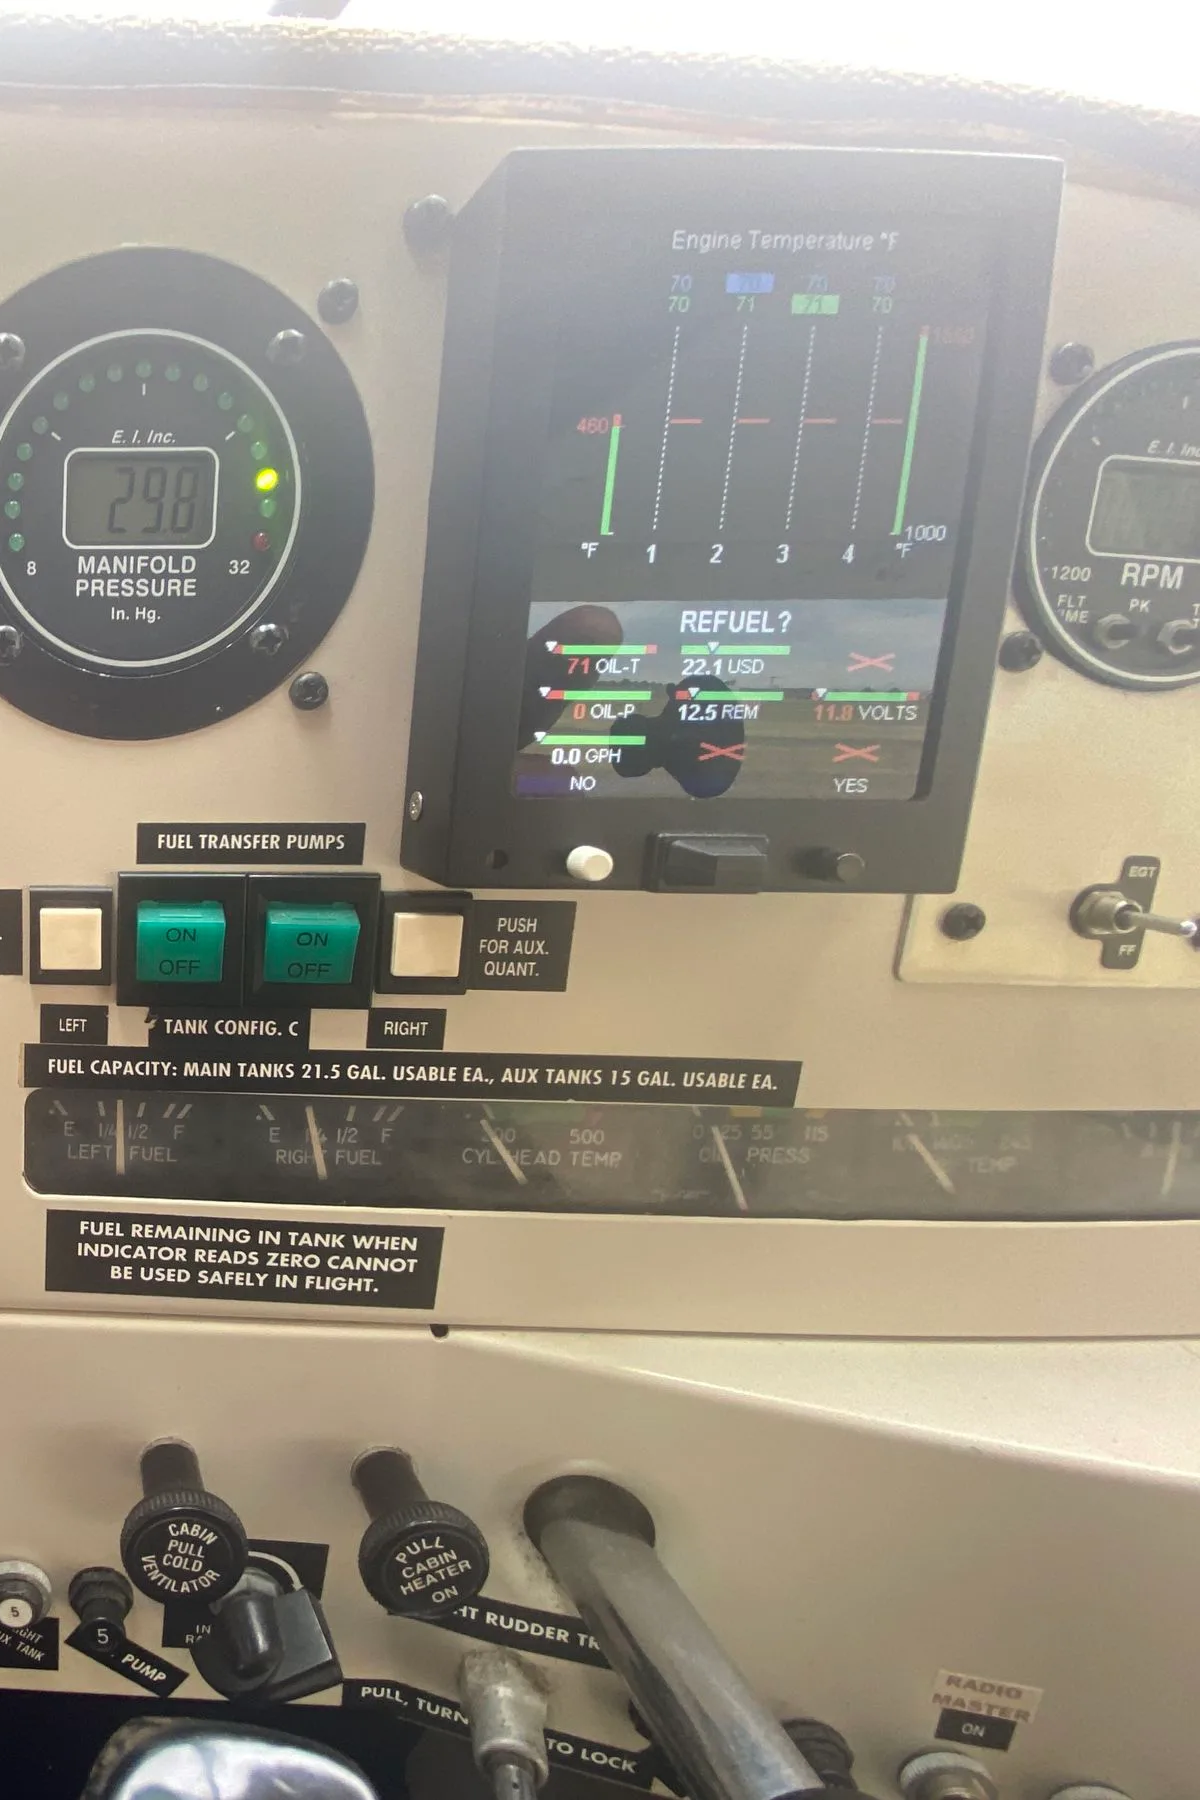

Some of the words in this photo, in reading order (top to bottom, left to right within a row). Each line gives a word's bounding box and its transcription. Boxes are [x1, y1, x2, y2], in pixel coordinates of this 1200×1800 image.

[672, 229, 742, 254] Engine
[748, 229, 874, 252] Temperature
[905, 525, 947, 541] 1000
[78, 556, 196, 574] MANIFOLD
[229, 561, 250, 575] 32
[1051, 566, 1091, 582] 1200
[1121, 564, 1184, 589] RPM
[76, 579, 197, 597] PRESSURE
[111, 607, 129, 620] In.
[136, 607, 161, 622] Hg.
[680, 610, 792, 633] REFUEL?
[682, 659, 721, 675] 22.1
[729, 659, 764, 674] USD
[678, 705, 717, 720] 12.5
[721, 705, 759, 720] REM
[859, 705, 917, 720] VOLTS
[570, 776, 596, 791] NO
[833, 778, 869, 793] YES
[157, 835, 193, 849] FUEL
[199, 835, 281, 850] TRANSFER
[286, 835, 345, 850] PUMPS
[1128, 866, 1156, 878] EGT
[166, 928, 197, 942] ON
[1118, 944, 1137, 956] FF
[159, 960, 200, 975] OFF
[59, 1018, 87, 1032] LEFT
[384, 1022, 428, 1036] RIGHT
[48, 1059, 84, 1074] FUEL
[90, 1060, 177, 1076] CAPACITY:
[183, 1062, 230, 1077] MAIN
[238, 1063, 293, 1078] TANKS
[301, 1064, 341, 1079] 21.5
[347, 1065, 386, 1081] GAL.
[393, 1066, 457, 1082] USABLE
[463, 1067, 494, 1085] EA.,
[502, 1068, 539, 1084] AUX
[546, 1069, 602, 1085] TANKS
[610, 1070, 630, 1085] 15
[637, 1070, 676, 1087] GAL.
[683, 1072, 747, 1089] USABLE
[751, 1073, 777, 1090] EA.
[68, 1145, 111, 1160] LEFT
[130, 1147, 177, 1162] FUEL
[80, 1221, 124, 1237] FUEL
[131, 1224, 250, 1243] REMAINING
[259, 1231, 281, 1244] IN
[289, 1232, 344, 1248] TANK
[353, 1235, 418, 1251] WHEN
[77, 1242, 187, 1262] INDICATOR
[195, 1249, 259, 1266] READS
[267, 1252, 320, 1268] ZERO
[327, 1255, 418, 1273] CANNOT
[110, 1266, 132, 1279] BE
[140, 1267, 190, 1283] USED
[198, 1270, 268, 1287] SAFELY
[276, 1274, 298, 1288] IN
[305, 1275, 379, 1292] FLIGHT.
[169, 1523, 218, 1545] CABIN
[168, 1539, 205, 1558] PULL
[395, 1537, 445, 1565] PULL
[163, 1554, 203, 1572] COLD
[401, 1549, 458, 1579] CABIN
[141, 1555, 221, 1593] VENTILATOR
[400, 1558, 473, 1597] HEATER
[945, 1674, 1025, 1700] RADIO
[932, 1693, 1032, 1722] MASTER
[961, 1722, 985, 1737] ON
